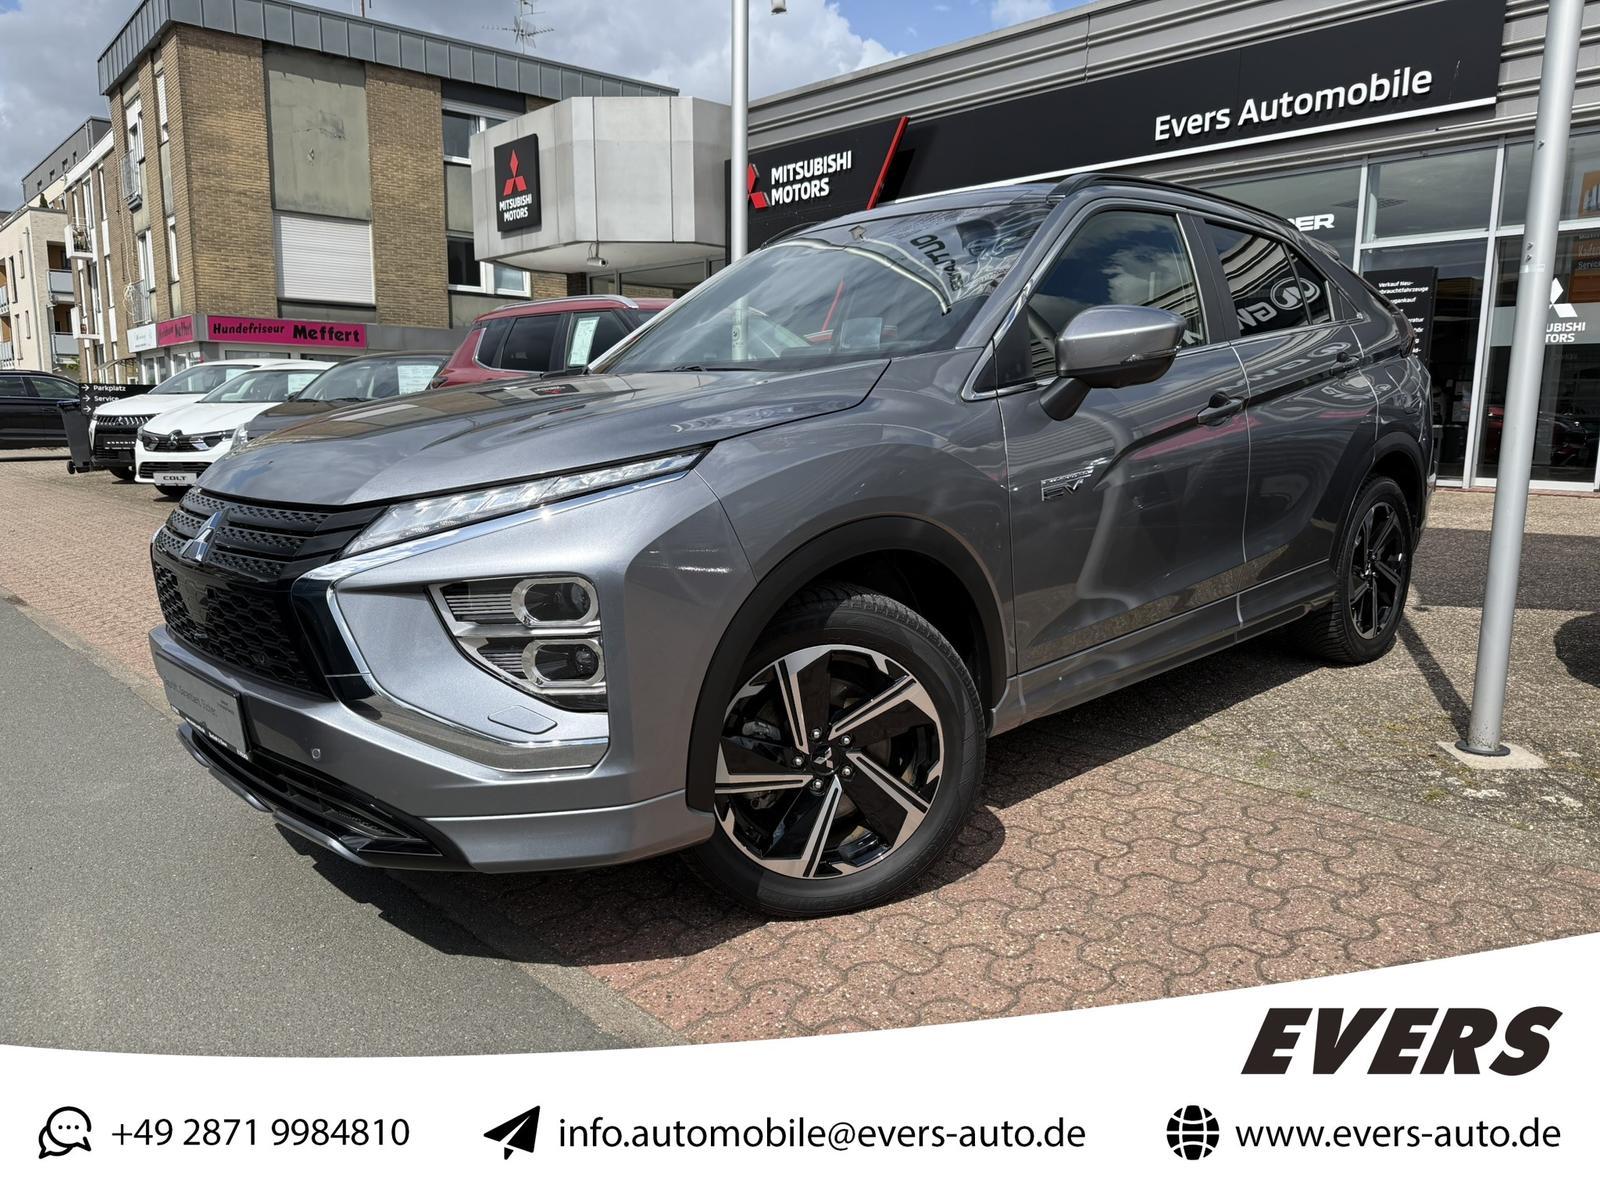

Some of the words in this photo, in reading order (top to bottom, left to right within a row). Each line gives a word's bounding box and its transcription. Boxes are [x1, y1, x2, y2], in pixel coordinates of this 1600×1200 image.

[1154, 107, 1231, 142] Evers
[1237, 66, 1433, 126] Automobile
[771, 151, 852, 185] MITSUBISHI
[771, 177, 830, 206] MOTORS
[499, 193, 533, 212] MITSUBISHI
[503, 207, 529, 222] MOTORS
[213, 322, 285, 335] Hundefriseur
[292, 324, 360, 343] Meffert
[1546, 321, 1586, 333] UBISHI
[1545, 333, 1575, 343] TORS
[93, 384, 126, 392] Parkplatz
